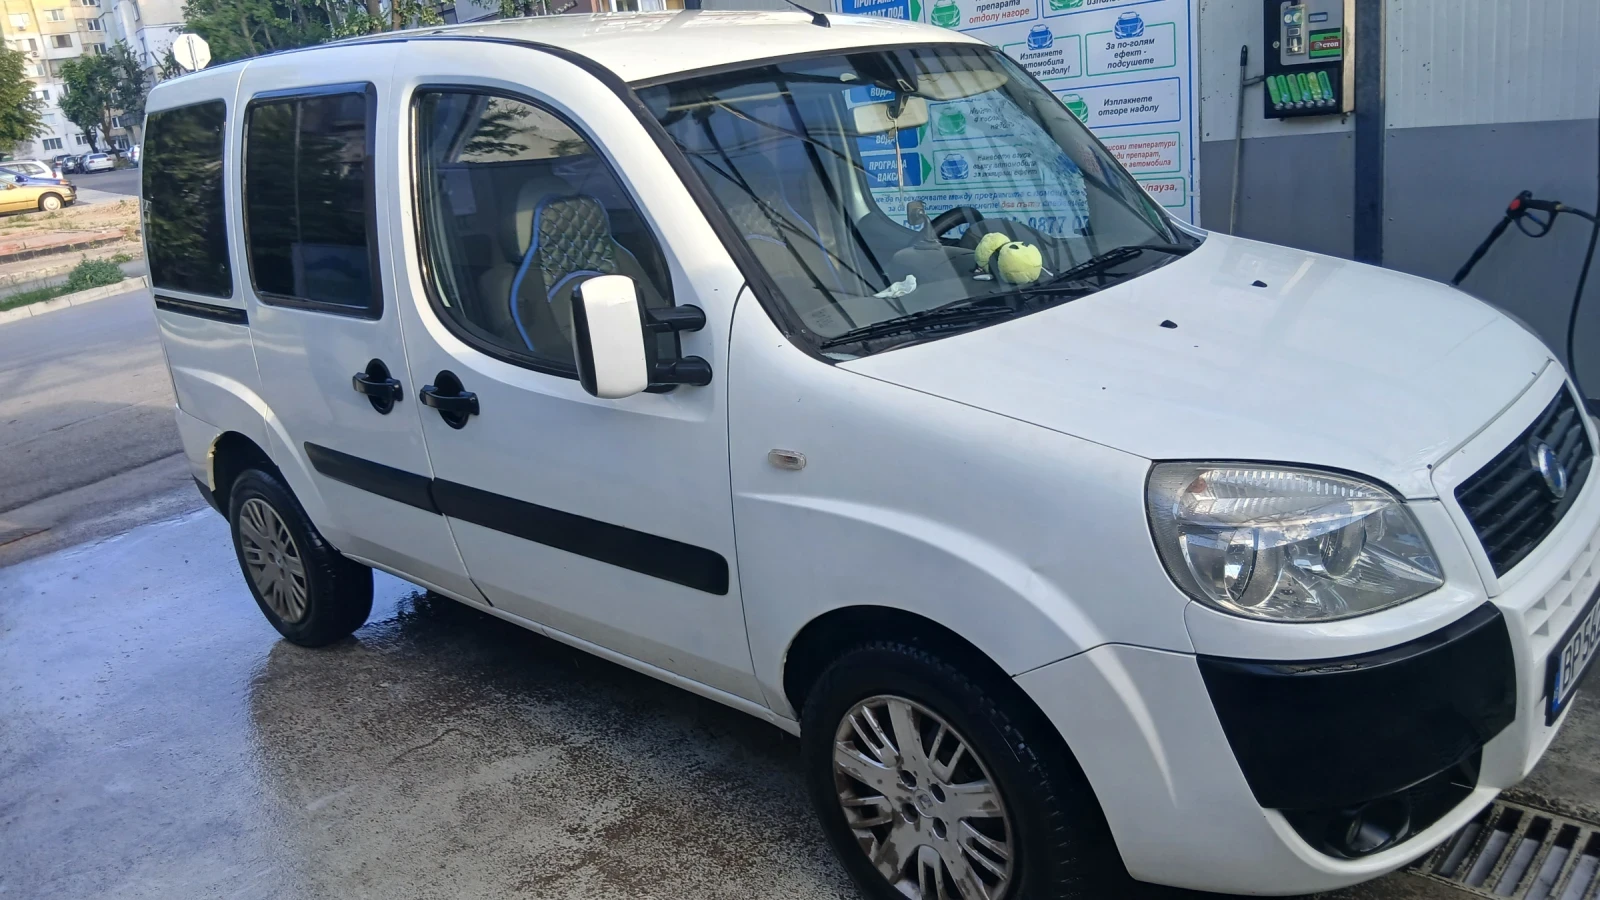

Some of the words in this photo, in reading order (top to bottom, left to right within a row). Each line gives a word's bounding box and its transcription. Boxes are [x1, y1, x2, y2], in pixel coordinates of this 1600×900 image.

[976, 0, 1021, 12] препарата
[887, 6, 904, 18] ПОД
[969, 12, 1000, 24] отдолу
[1001, 7, 1030, 19] нагоре
[1105, 42, 1116, 50] За
[1117, 38, 1155, 49] по-голям
[1020, 49, 1063, 60] Изплакнете
[1114, 50, 1142, 59] ефект
[1107, 57, 1155, 69] подсушете
[1042, 65, 1071, 76] надолу!
[1103, 95, 1153, 107] Изплакнете
[1098, 107, 1128, 116] отгоре
[1129, 104, 1160, 113] надолу
[1128, 140, 1177, 150] температури
[1126, 151, 1161, 160] препарат,
[868, 159, 908, 170] ПРОГРАА
[1128, 159, 1172, 168] автомобила
[1142, 183, 1178, 193] /пауза,
